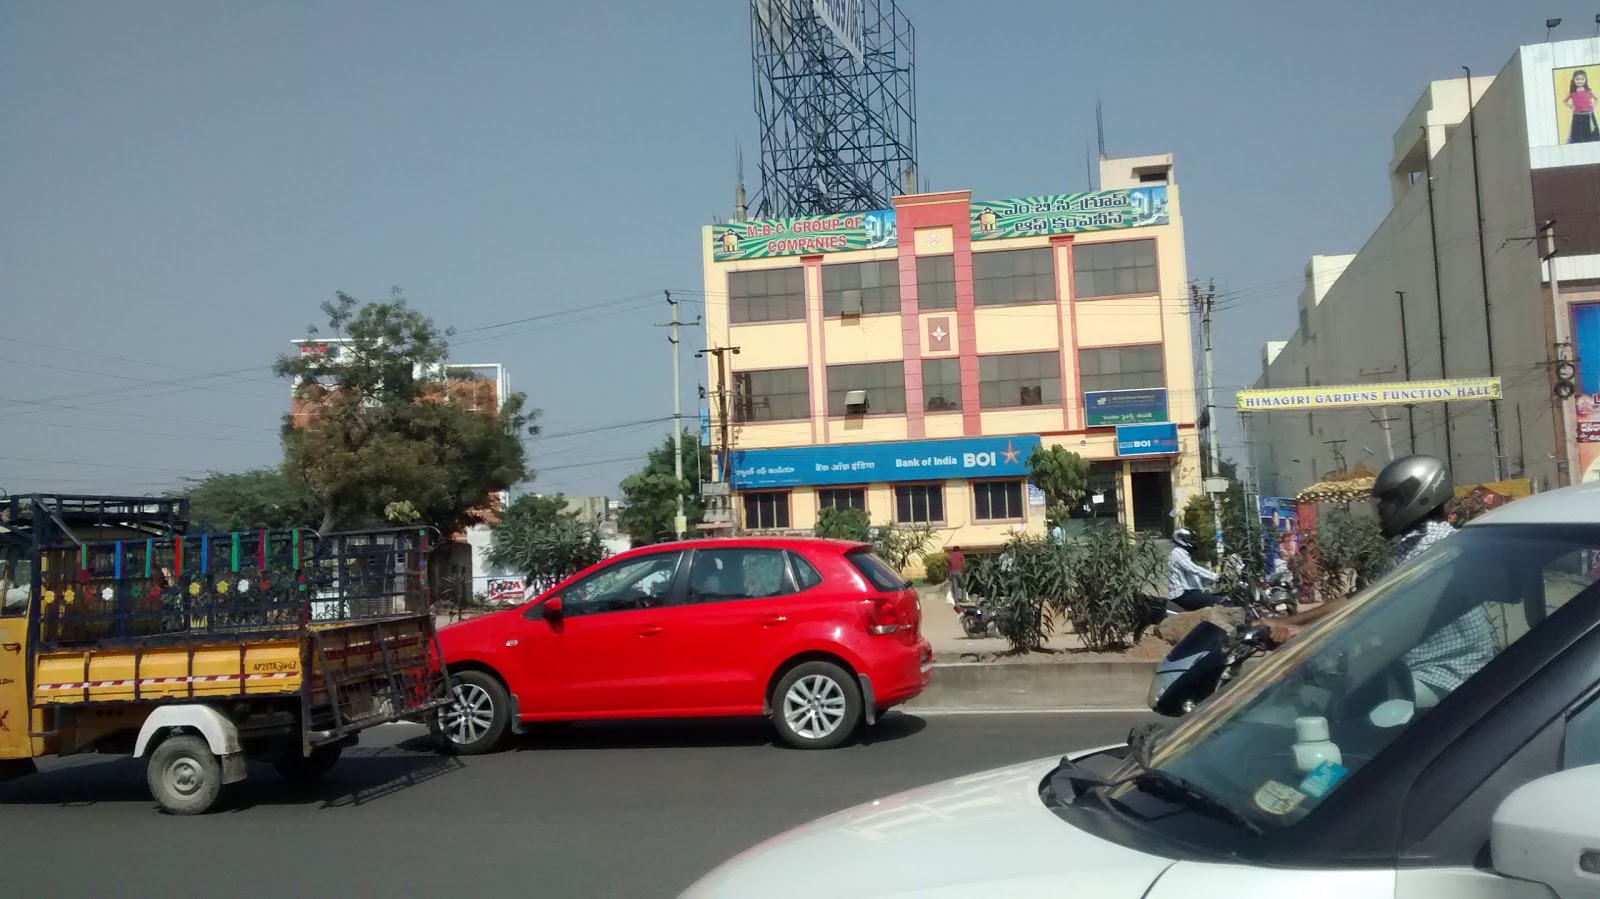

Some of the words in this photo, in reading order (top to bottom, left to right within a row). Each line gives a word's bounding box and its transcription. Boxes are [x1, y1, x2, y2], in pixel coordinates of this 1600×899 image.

[1079, 192, 1127, 211] గ్రూప్
[793, 219, 840, 233] GROUP
[845, 217, 862, 229] OF
[767, 236, 847, 252] COMPANIES
[1246, 395, 1310, 406] HIMAGIRI
[1315, 391, 1378, 403] GARDENS
[1383, 388, 1452, 400] FUNCTION
[1457, 385, 1491, 397] HALL
[1133, 440, 1151, 448] BOI
[851, 460, 875, 471] इंडिया
[895, 458, 920, 467] Bank
[922, 457, 931, 466] of
[934, 456, 957, 465] India
[963, 452, 997, 467] BOI
